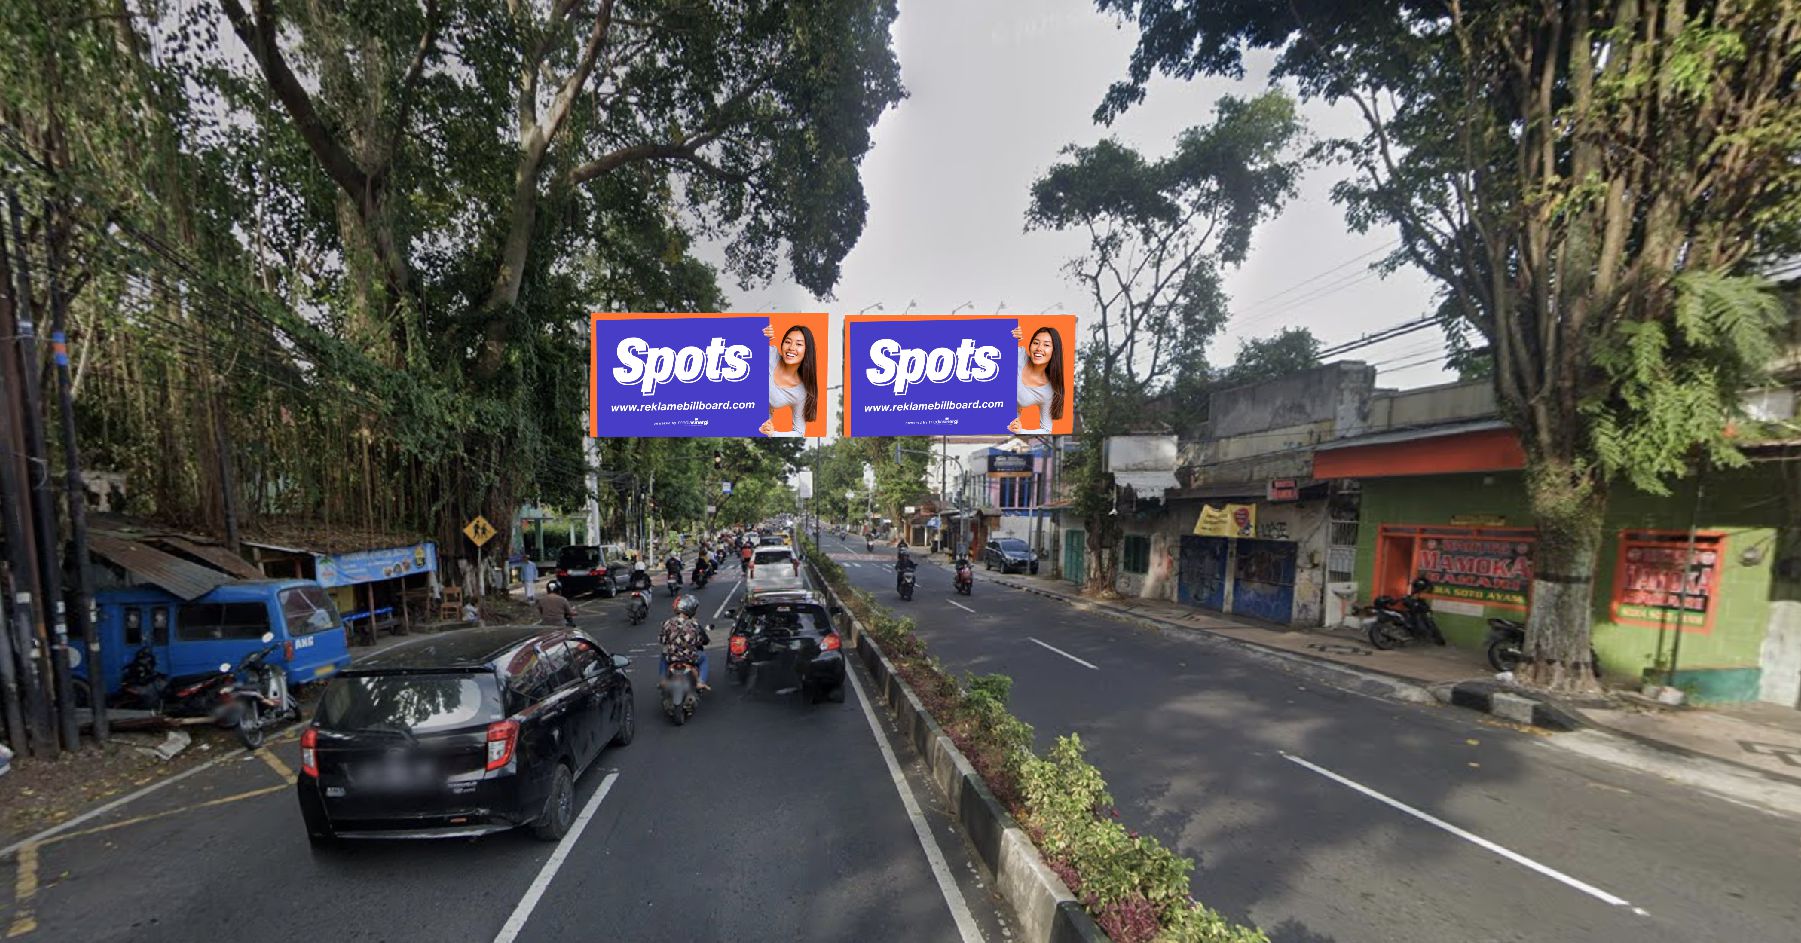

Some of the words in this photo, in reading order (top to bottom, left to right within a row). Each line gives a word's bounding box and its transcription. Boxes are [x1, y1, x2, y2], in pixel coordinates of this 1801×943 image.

[613, 337, 752, 396] Spots
[866, 338, 1002, 396] Spots
[611, 400, 756, 412] www.reklamebillboard.com
[864, 399, 1004, 412] www.reklamebillboard.com
[1419, 550, 1534, 579] MAMOKA
